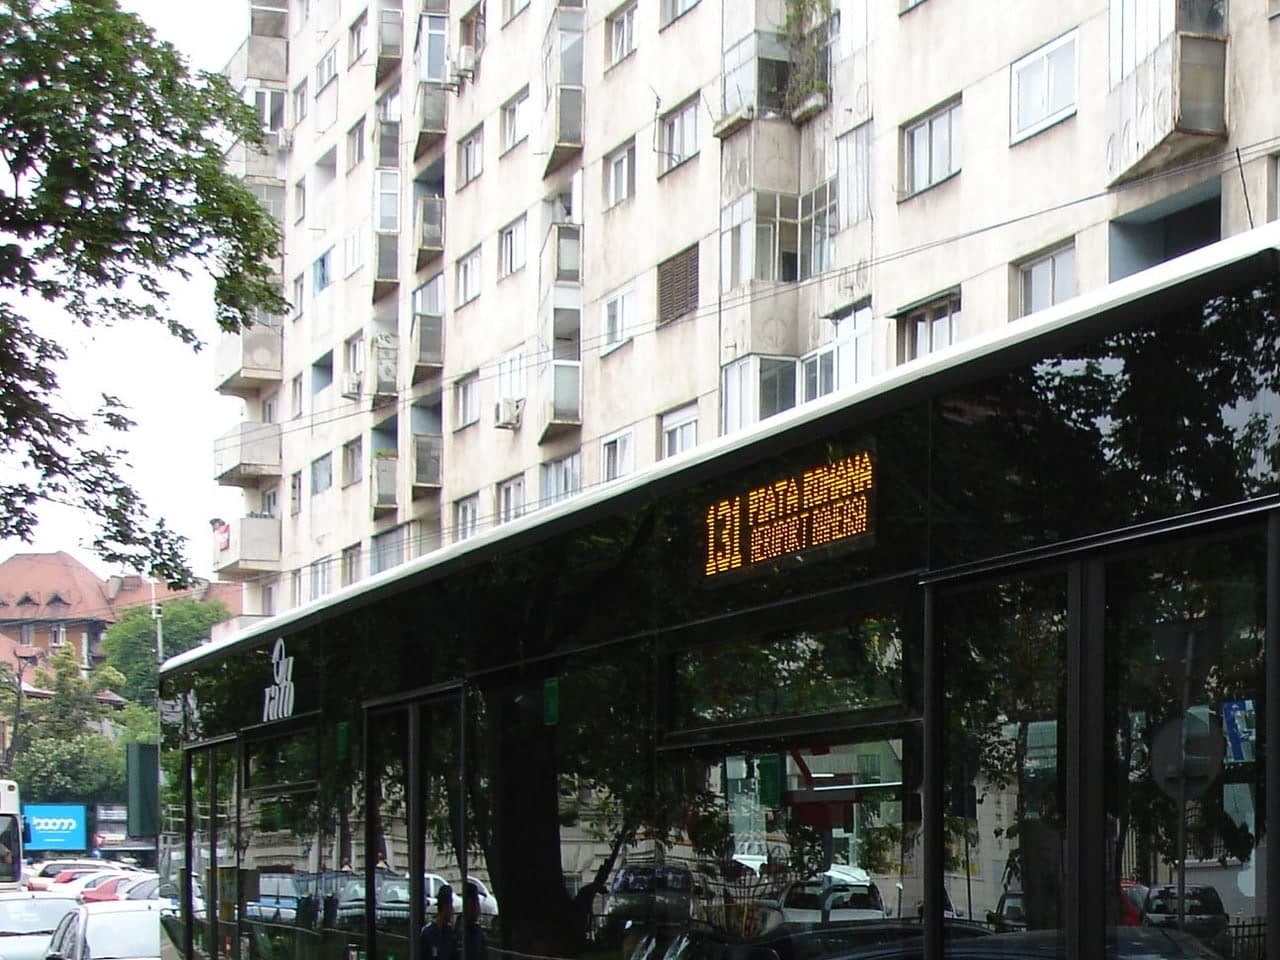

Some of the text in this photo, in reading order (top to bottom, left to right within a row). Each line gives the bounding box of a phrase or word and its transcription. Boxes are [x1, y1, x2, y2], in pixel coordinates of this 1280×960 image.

[748, 451, 873, 526] PIATA ROMANA
[706, 495, 742, 576] 131
